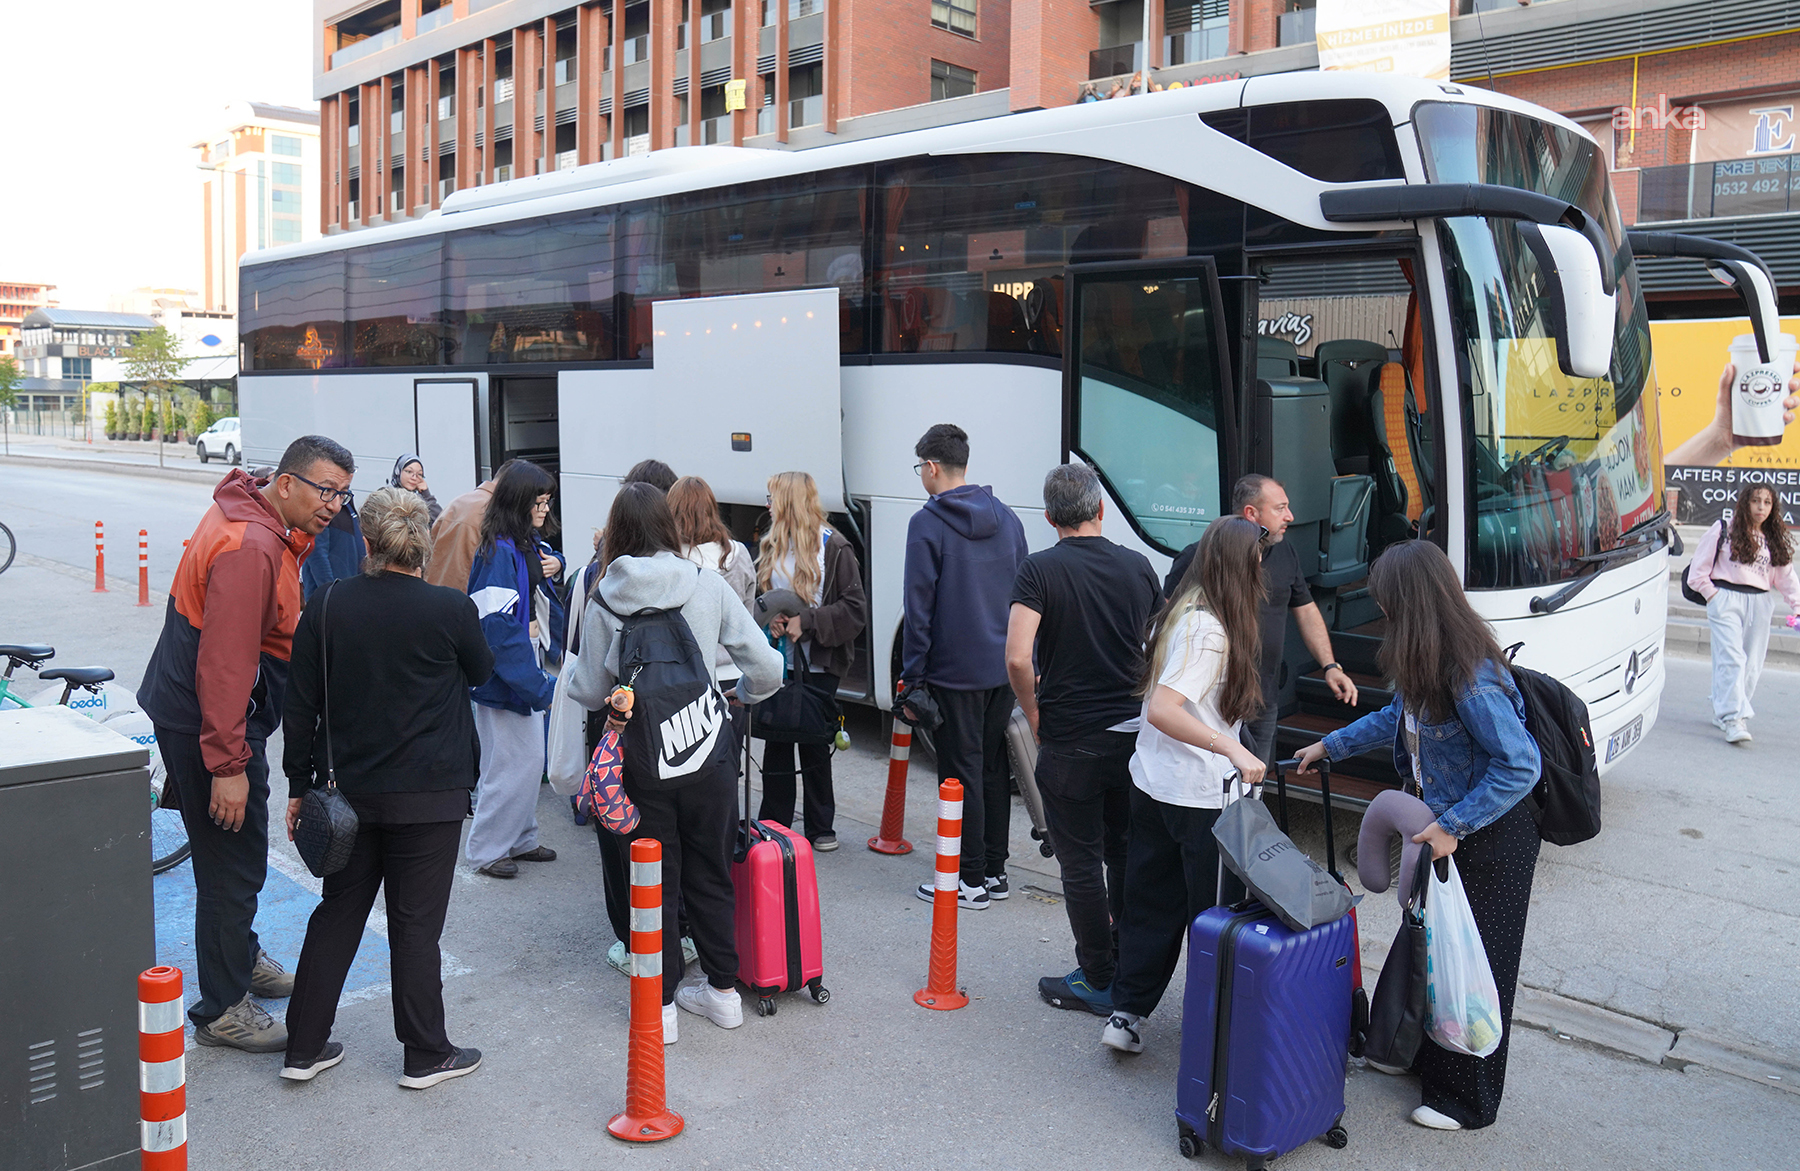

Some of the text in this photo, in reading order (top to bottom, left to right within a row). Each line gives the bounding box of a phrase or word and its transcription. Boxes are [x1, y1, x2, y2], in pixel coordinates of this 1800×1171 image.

[1327, 19, 1435, 46] HİZMETİNİZDE
[1714, 161, 1755, 178] EMRE
[1714, 180, 1748, 197] 0532
[1752, 178, 1780, 193] 492
[1671, 468, 1800, 486] AFTER 5 KONSE
[1702, 488, 1738, 504] ÇOK
[660, 683, 718, 761] NIKE
